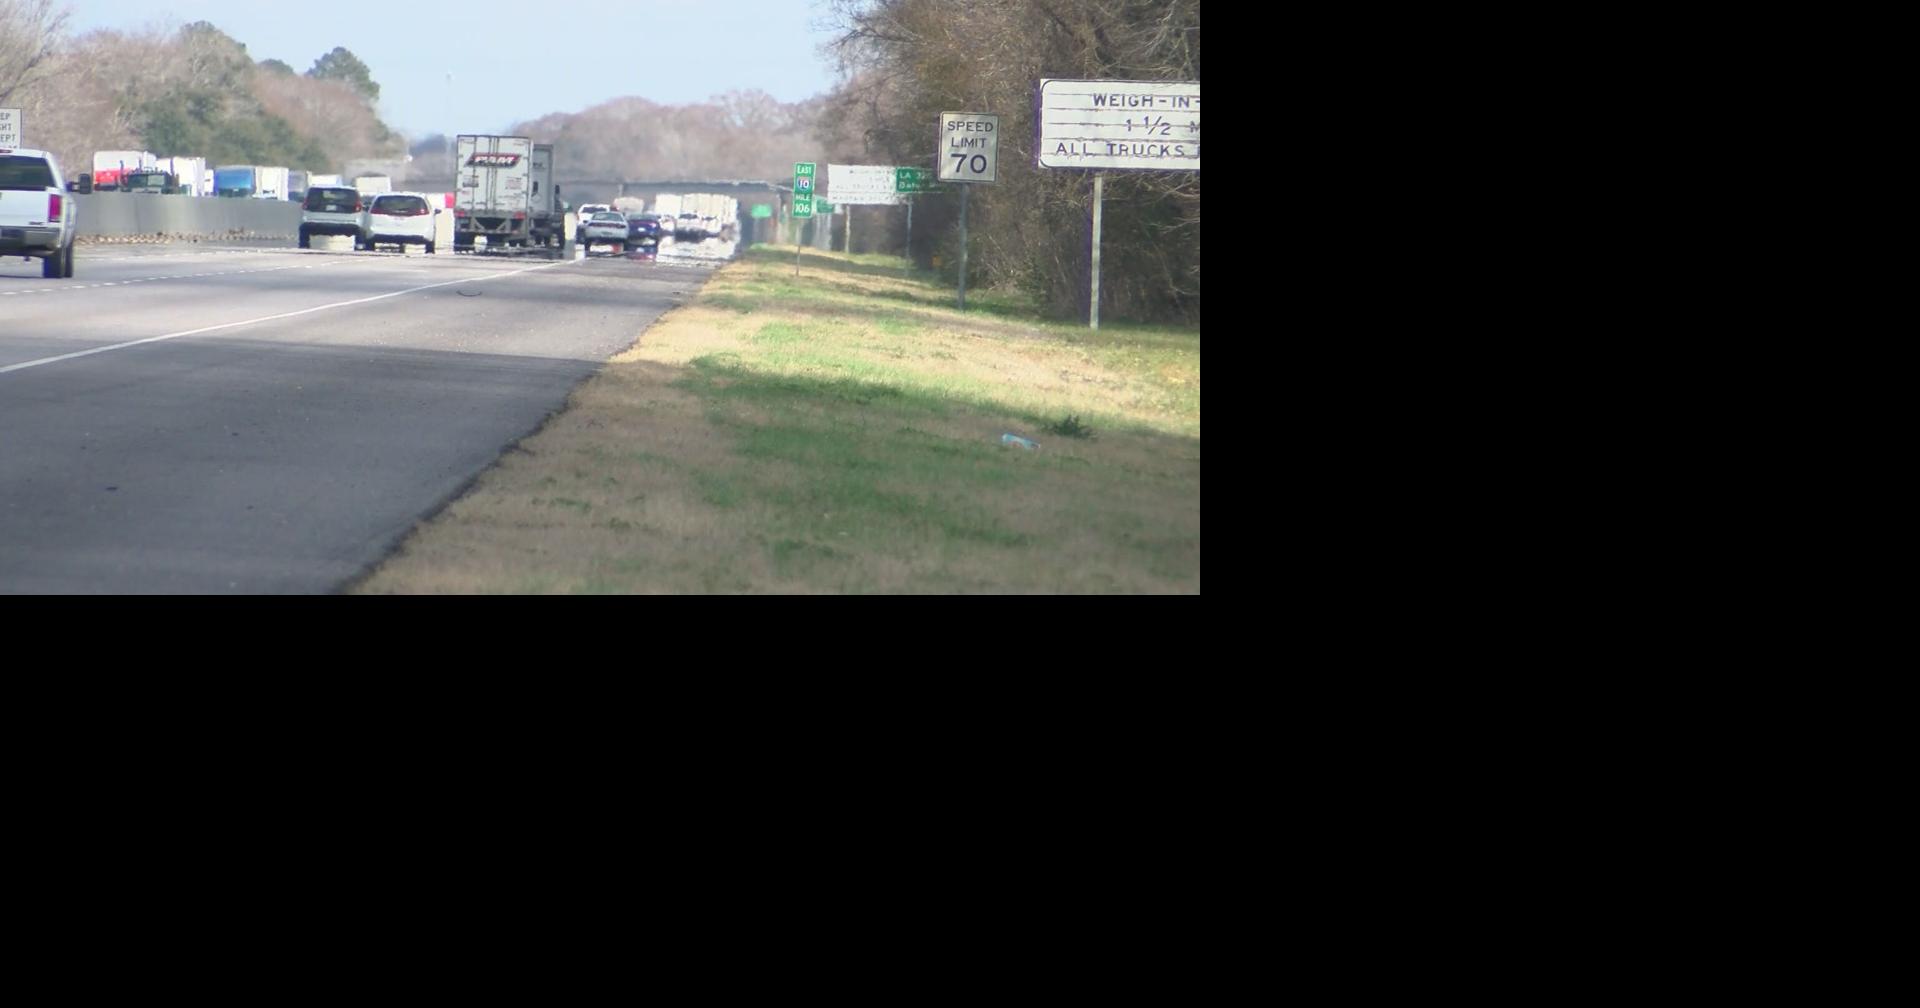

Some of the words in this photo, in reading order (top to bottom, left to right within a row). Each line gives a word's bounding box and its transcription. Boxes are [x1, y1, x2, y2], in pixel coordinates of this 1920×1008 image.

[947, 120, 994, 132] SPEED
[1126, 119, 1132, 132] 1
[951, 136, 988, 149] LIMIT
[1055, 142, 1093, 156] ALL
[1106, 142, 1185, 158] TRUCKS
[796, 164, 812, 175] EAST
[950, 153, 988, 174] 70
[799, 178, 810, 189] 10
[795, 202, 810, 213] 106
